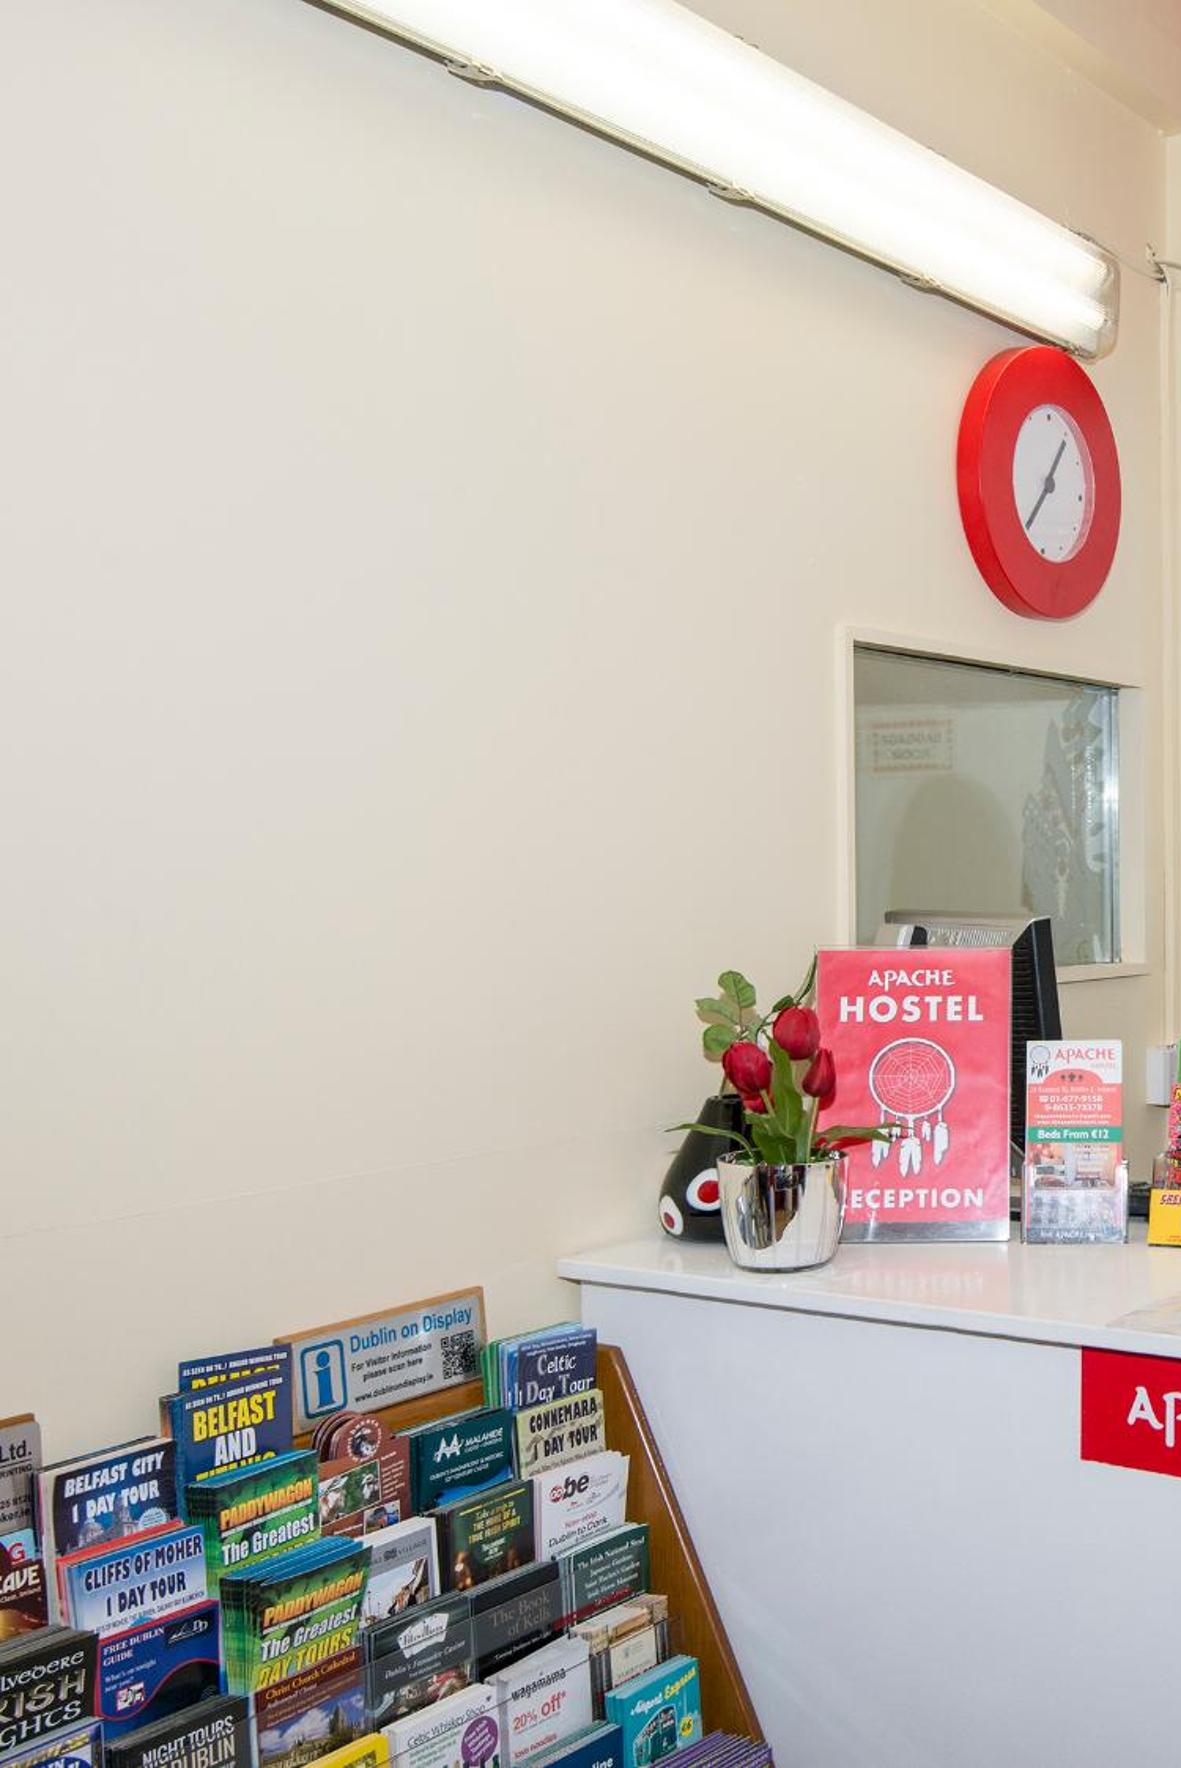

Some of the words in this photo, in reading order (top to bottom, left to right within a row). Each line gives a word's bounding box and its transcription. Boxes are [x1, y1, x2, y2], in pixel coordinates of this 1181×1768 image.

[868, 969, 956, 991] APACHE
[839, 995, 984, 1023] HOSTEL
[1055, 1047, 1116, 1064] APACHE
[1038, 1129, 1061, 1139] Beds
[1063, 1129, 1089, 1139] From
[1091, 1129, 1110, 1139] €12
[846, 1188, 984, 1210] ECEPTION
[350, 1328, 398, 1352] Dublin
[401, 1321, 419, 1338] on
[422, 1306, 472, 1332] Display
[351, 1362, 365, 1373] For
[365, 1353, 391, 1368] Visitor
[363, 1368, 388, 1382] please
[407, 1357, 423, 1370] here
[537, 1354, 577, 1377] Celtic
[527, 1381, 555, 1405] Day
[558, 1373, 595, 1394] Tour
[193, 1390, 277, 1443] BELFAST
[529, 1396, 598, 1434] CONNEMARA
[214, 1427, 257, 1467] AND
[544, 1434, 565, 1457] DAY
[569, 1424, 598, 1448] TOUR
[64, 1461, 129, 1498] BELFAST
[131, 1451, 165, 1474] CITY
[86, 1492, 117, 1519] DAY
[121, 1479, 160, 1506] TOUR
[220, 1477, 313, 1532] PADDYWAGON
[221, 1539, 249, 1567] The
[252, 1513, 315, 1554] Greatest
[84, 1558, 130, 1592] CLIFFS
[134, 1556, 150, 1575] OF
[155, 1534, 203, 1568] MOHER
[118, 1582, 147, 1613] DAY
[151, 1570, 187, 1600] TOUR
[263, 1571, 364, 1630] PADDYWAGON
[494, 1610, 514, 1627] The
[522, 1596, 549, 1613] Book
[508, 1623, 520, 1635] of
[522, 1609, 550, 1630] Kells
[103, 1641, 129, 1656] FREE
[129, 1626, 165, 1646] DUBLIN
[260, 1633, 291, 1662] The
[293, 1604, 358, 1647] Greatest
[103, 1650, 133, 1667] GUIDE
[256, 1654, 294, 1691] DAY
[296, 1627, 352, 1671] TOURS
[292, 1670, 321, 1690] Church
[321, 1651, 358, 1674] Cathedral
[511, 1668, 567, 1701] wagamama
[407, 1731, 431, 1748] Celtic
[432, 1713, 465, 1737] Whiskey
[465, 1703, 487, 1721] Shop
[513, 1711, 538, 1731] 20%
[142, 1735, 188, 1768] NIGHT
[188, 1714, 235, 1748] TOURS
